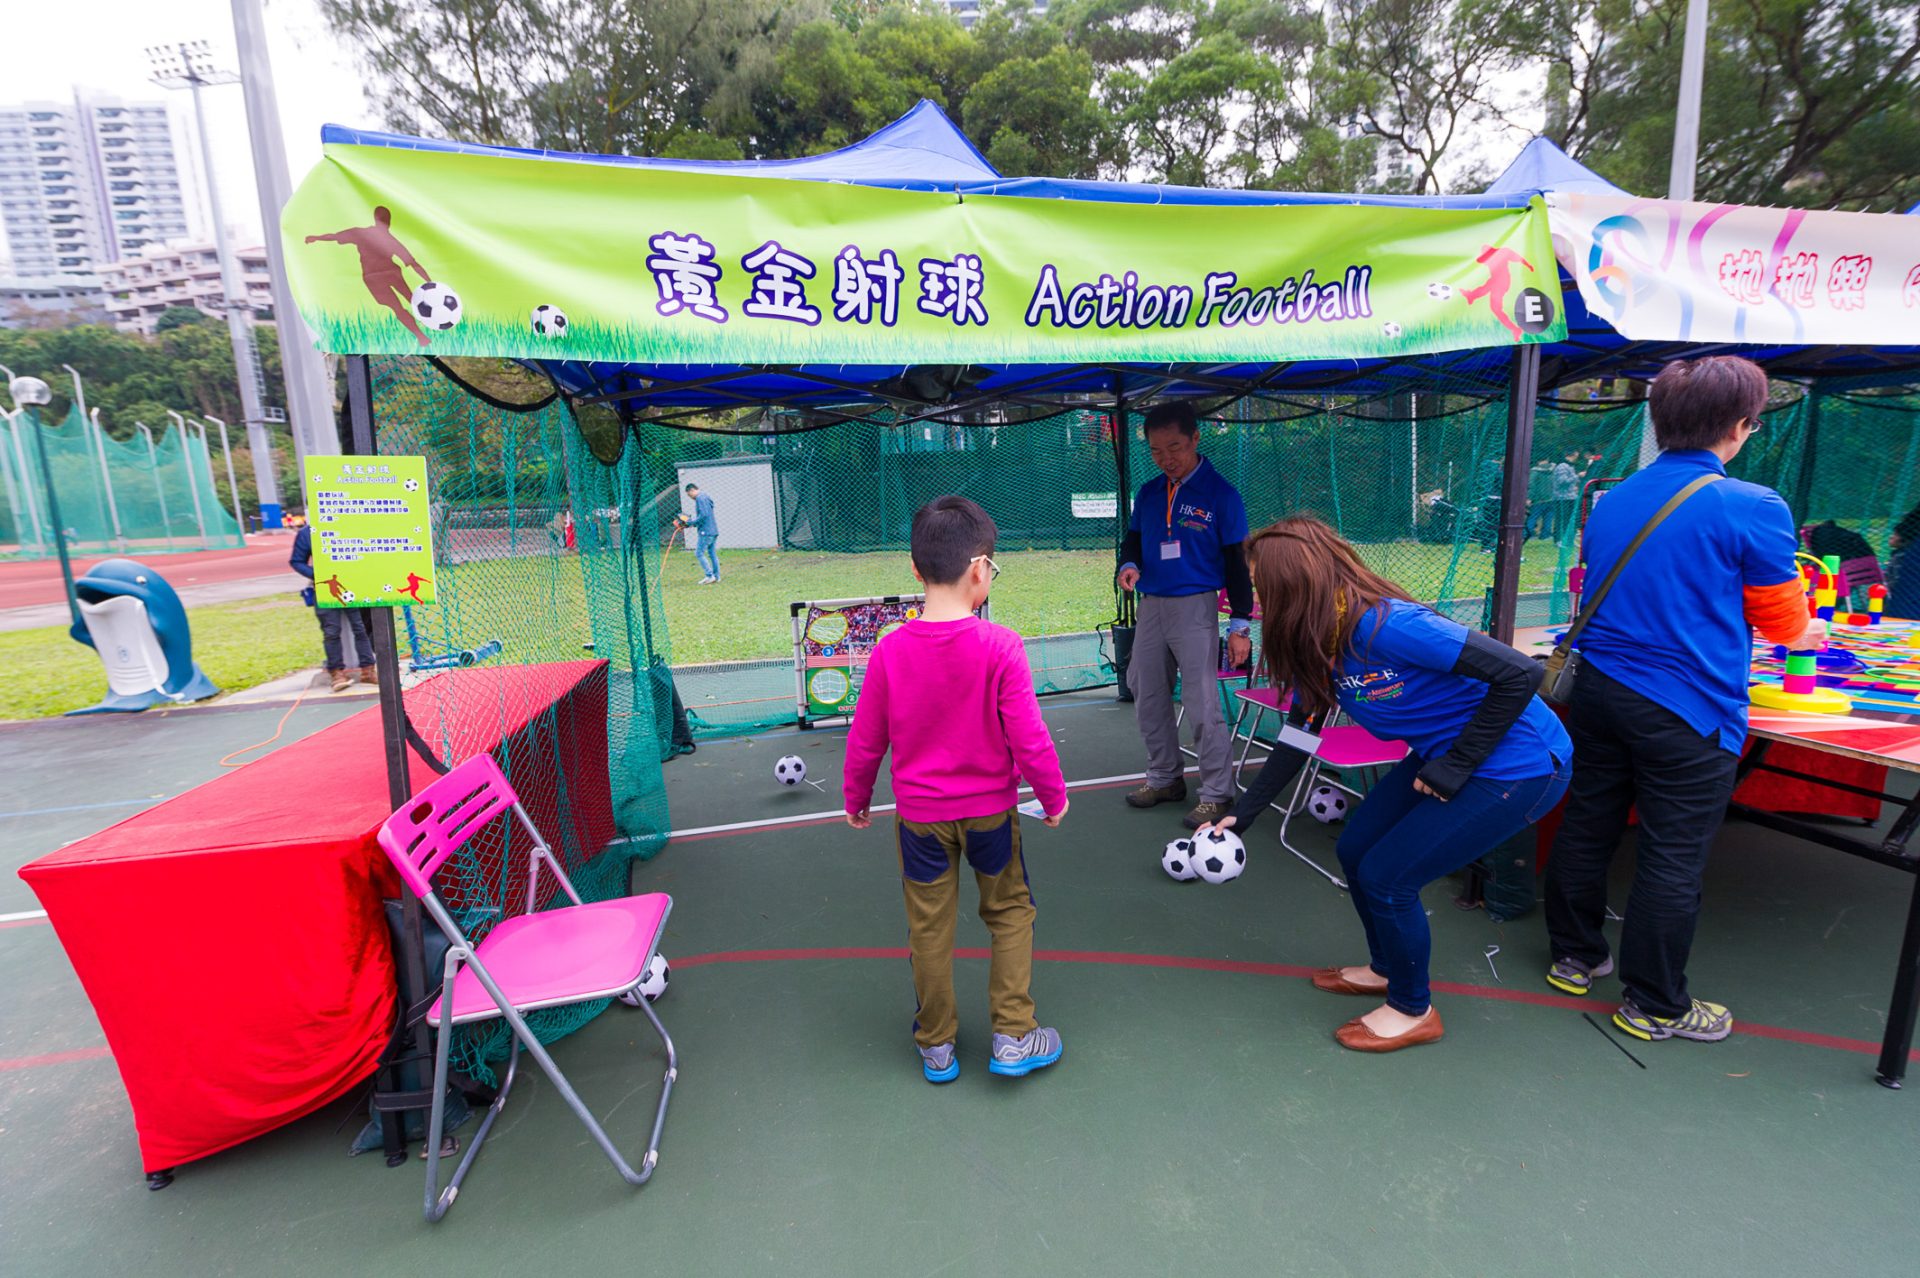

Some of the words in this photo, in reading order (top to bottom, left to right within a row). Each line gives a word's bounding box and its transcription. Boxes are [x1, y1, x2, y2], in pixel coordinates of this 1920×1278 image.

[647, 231, 989, 327] 黃金射球
[1024, 263, 1192, 329] Action
[1195, 264, 1373, 327] Football
[1525, 296, 1544, 322] E
